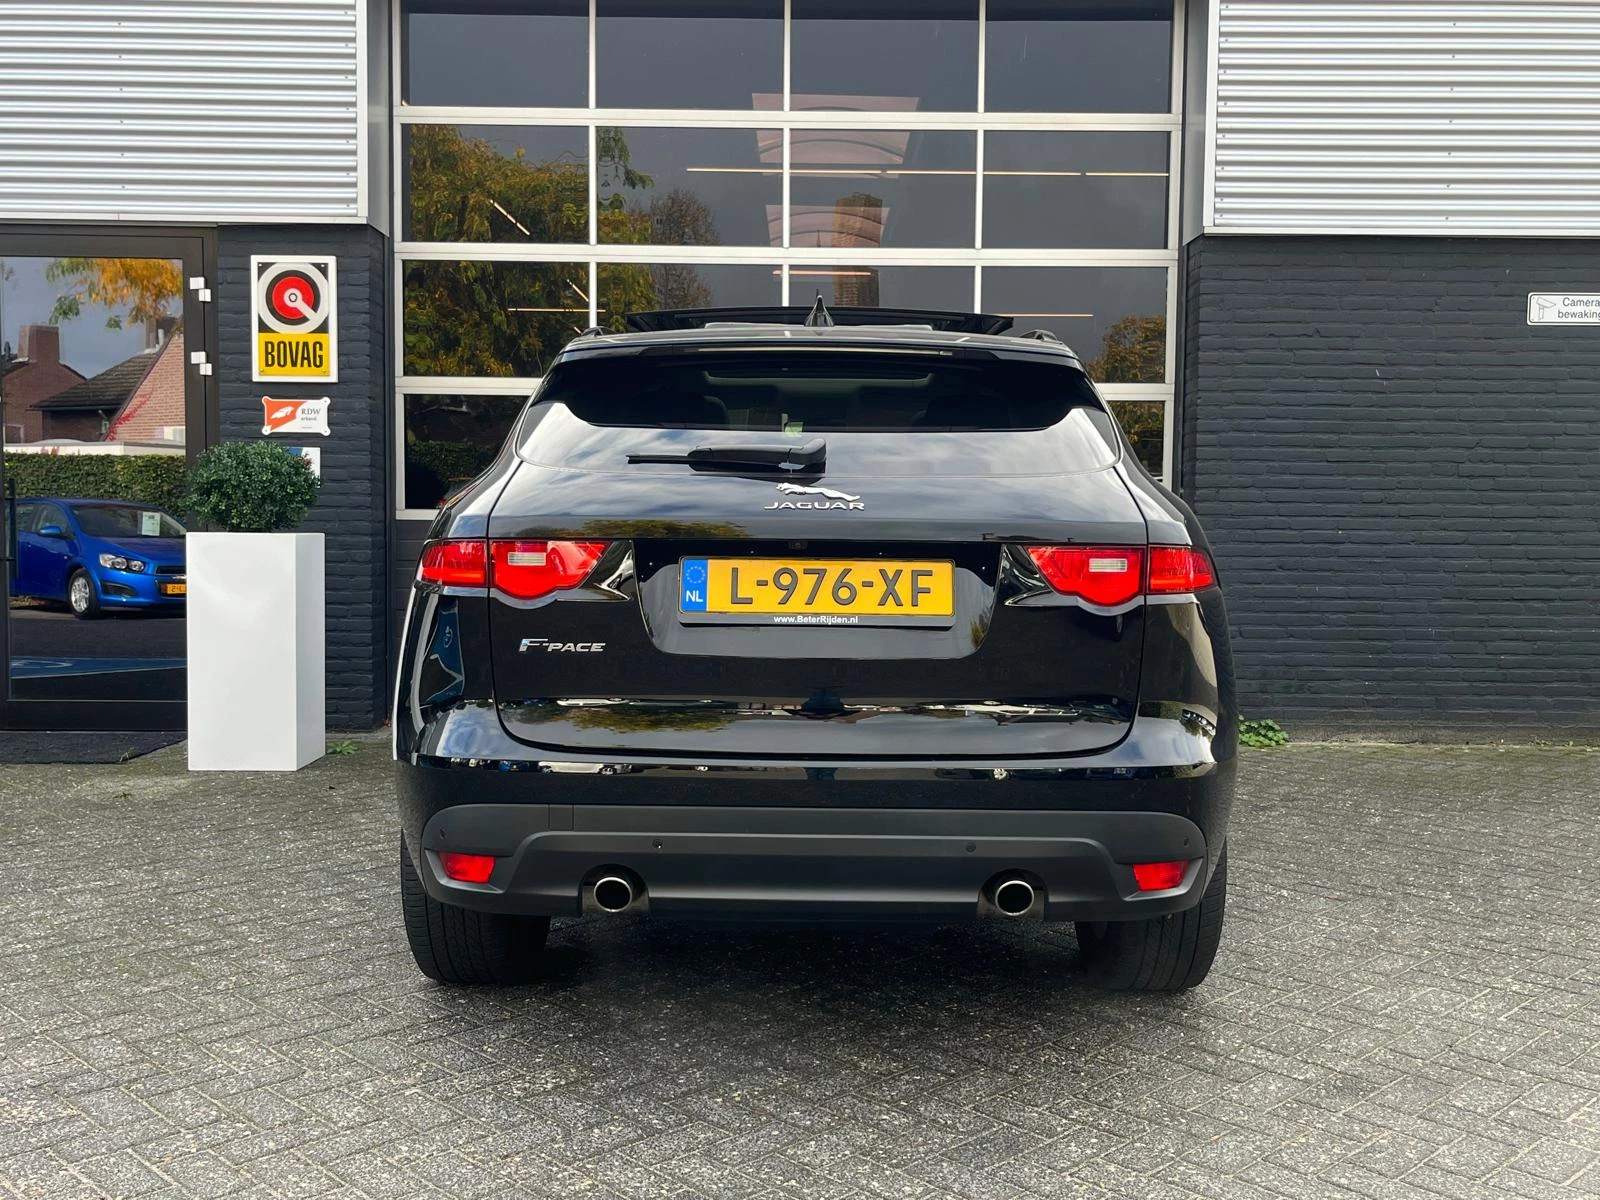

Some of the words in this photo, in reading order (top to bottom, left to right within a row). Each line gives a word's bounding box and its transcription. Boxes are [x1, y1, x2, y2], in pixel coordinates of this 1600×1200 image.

[1562, 297, 1600, 307] Camera
[264, 340, 323, 368] BOVAG
[764, 501, 865, 511] JAGUAR
[730, 567, 933, 607] L-976-XF
[686, 590, 703, 602] NL
[774, 615, 859, 625] www.BeterRijden.nl
